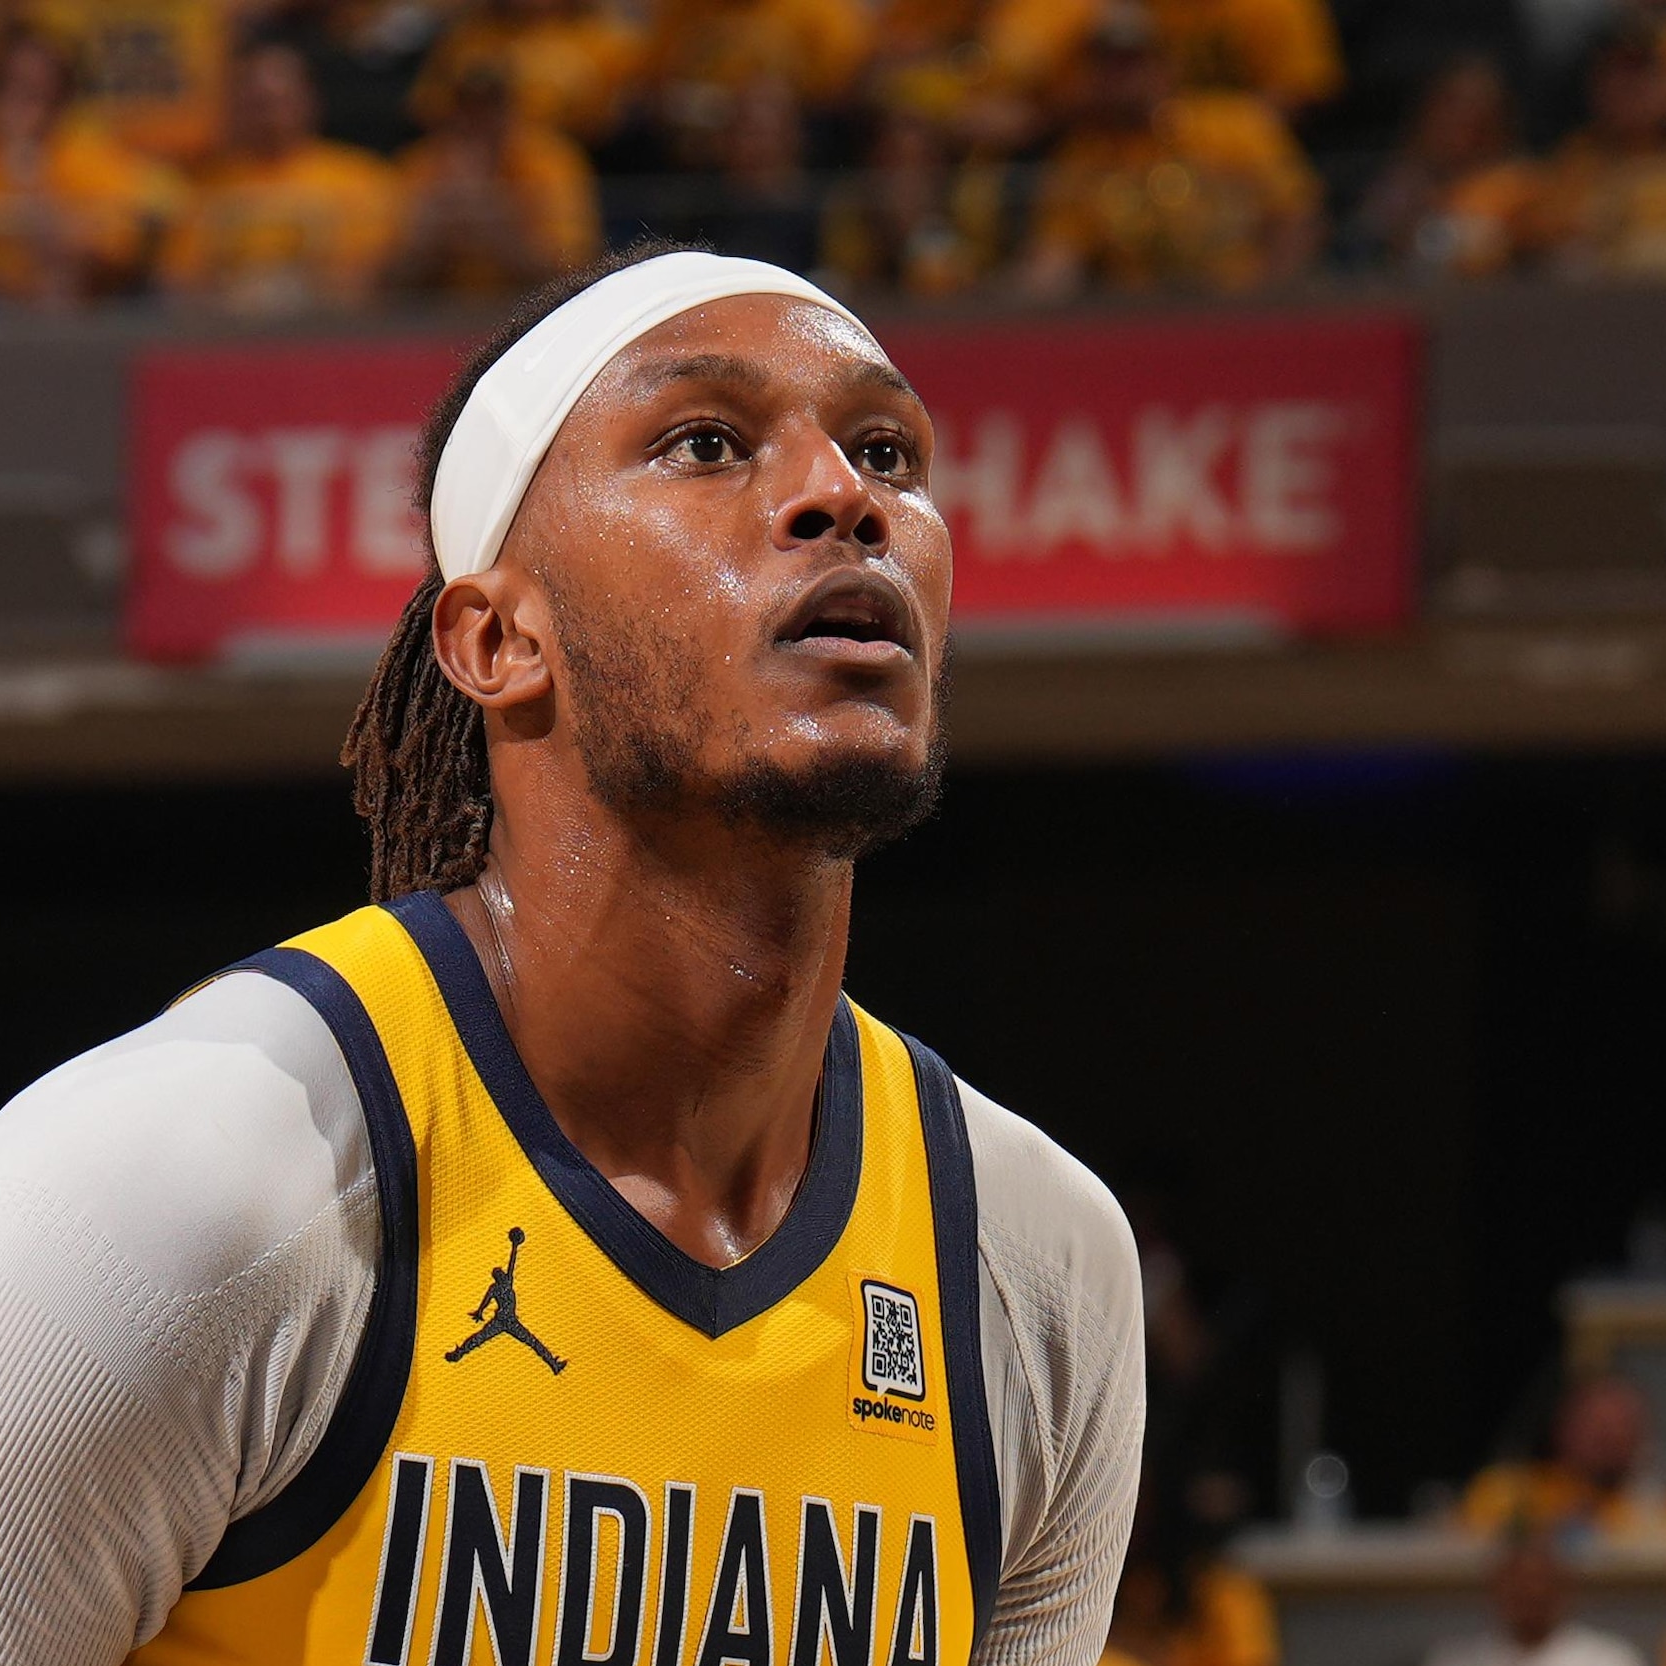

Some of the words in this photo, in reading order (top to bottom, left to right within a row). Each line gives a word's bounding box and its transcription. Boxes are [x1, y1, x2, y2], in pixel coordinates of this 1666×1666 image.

[165, 420, 425, 578] STE
[935, 400, 1339, 553] HAKE
[853, 1397, 935, 1431] spokenote
